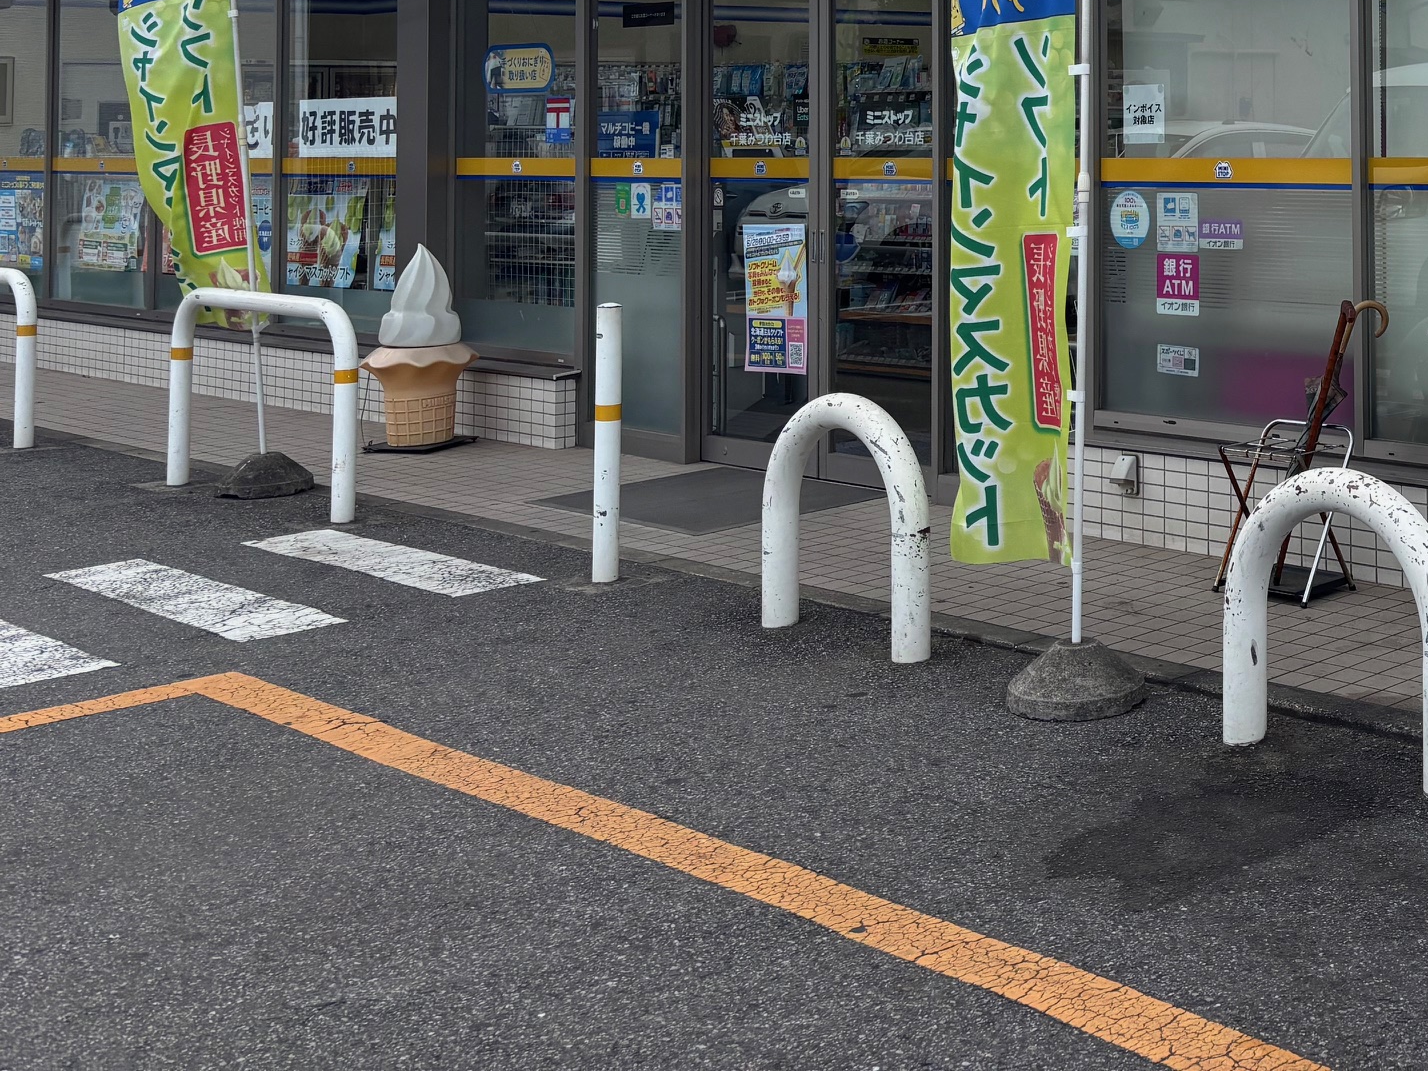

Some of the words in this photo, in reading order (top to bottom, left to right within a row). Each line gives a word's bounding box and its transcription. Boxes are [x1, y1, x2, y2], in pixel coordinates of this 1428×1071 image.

[1126, 103, 1162, 114] インボイス
[739, 110, 782, 126] ミニストップ
[866, 109, 914, 125] ミニストップ
[301, 108, 397, 146] 好評販売中
[600, 121, 650, 135] マルチコピー機
[729, 132, 792, 146] 千葉みつわ台店
[855, 131, 925, 146] 千葉みつわ台店
[1202, 223, 1240, 235] 銀行ATM
[1207, 240, 1235, 248] イオン銀行
[1163, 258, 1193, 277] 銀行
[1163, 279, 1194, 296] ATM
[1161, 301, 1195, 312] イオン銀行
